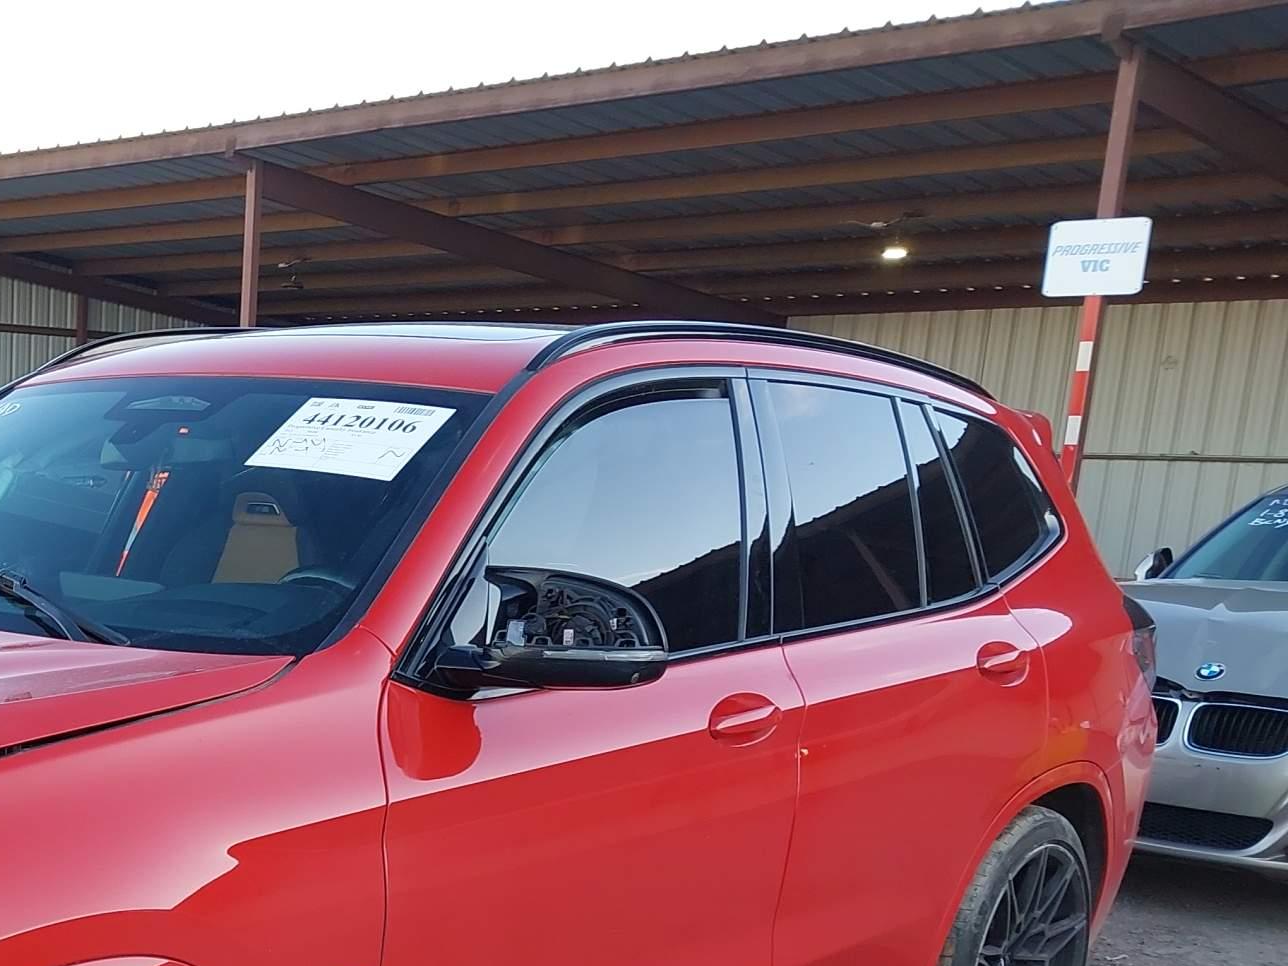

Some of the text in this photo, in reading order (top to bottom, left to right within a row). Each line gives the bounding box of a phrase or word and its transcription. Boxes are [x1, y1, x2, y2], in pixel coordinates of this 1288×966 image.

[1052, 242, 1142, 256] PROGRESSIVE
[1080, 259, 1111, 272] VIC
[302, 412, 423, 434] 44120106
